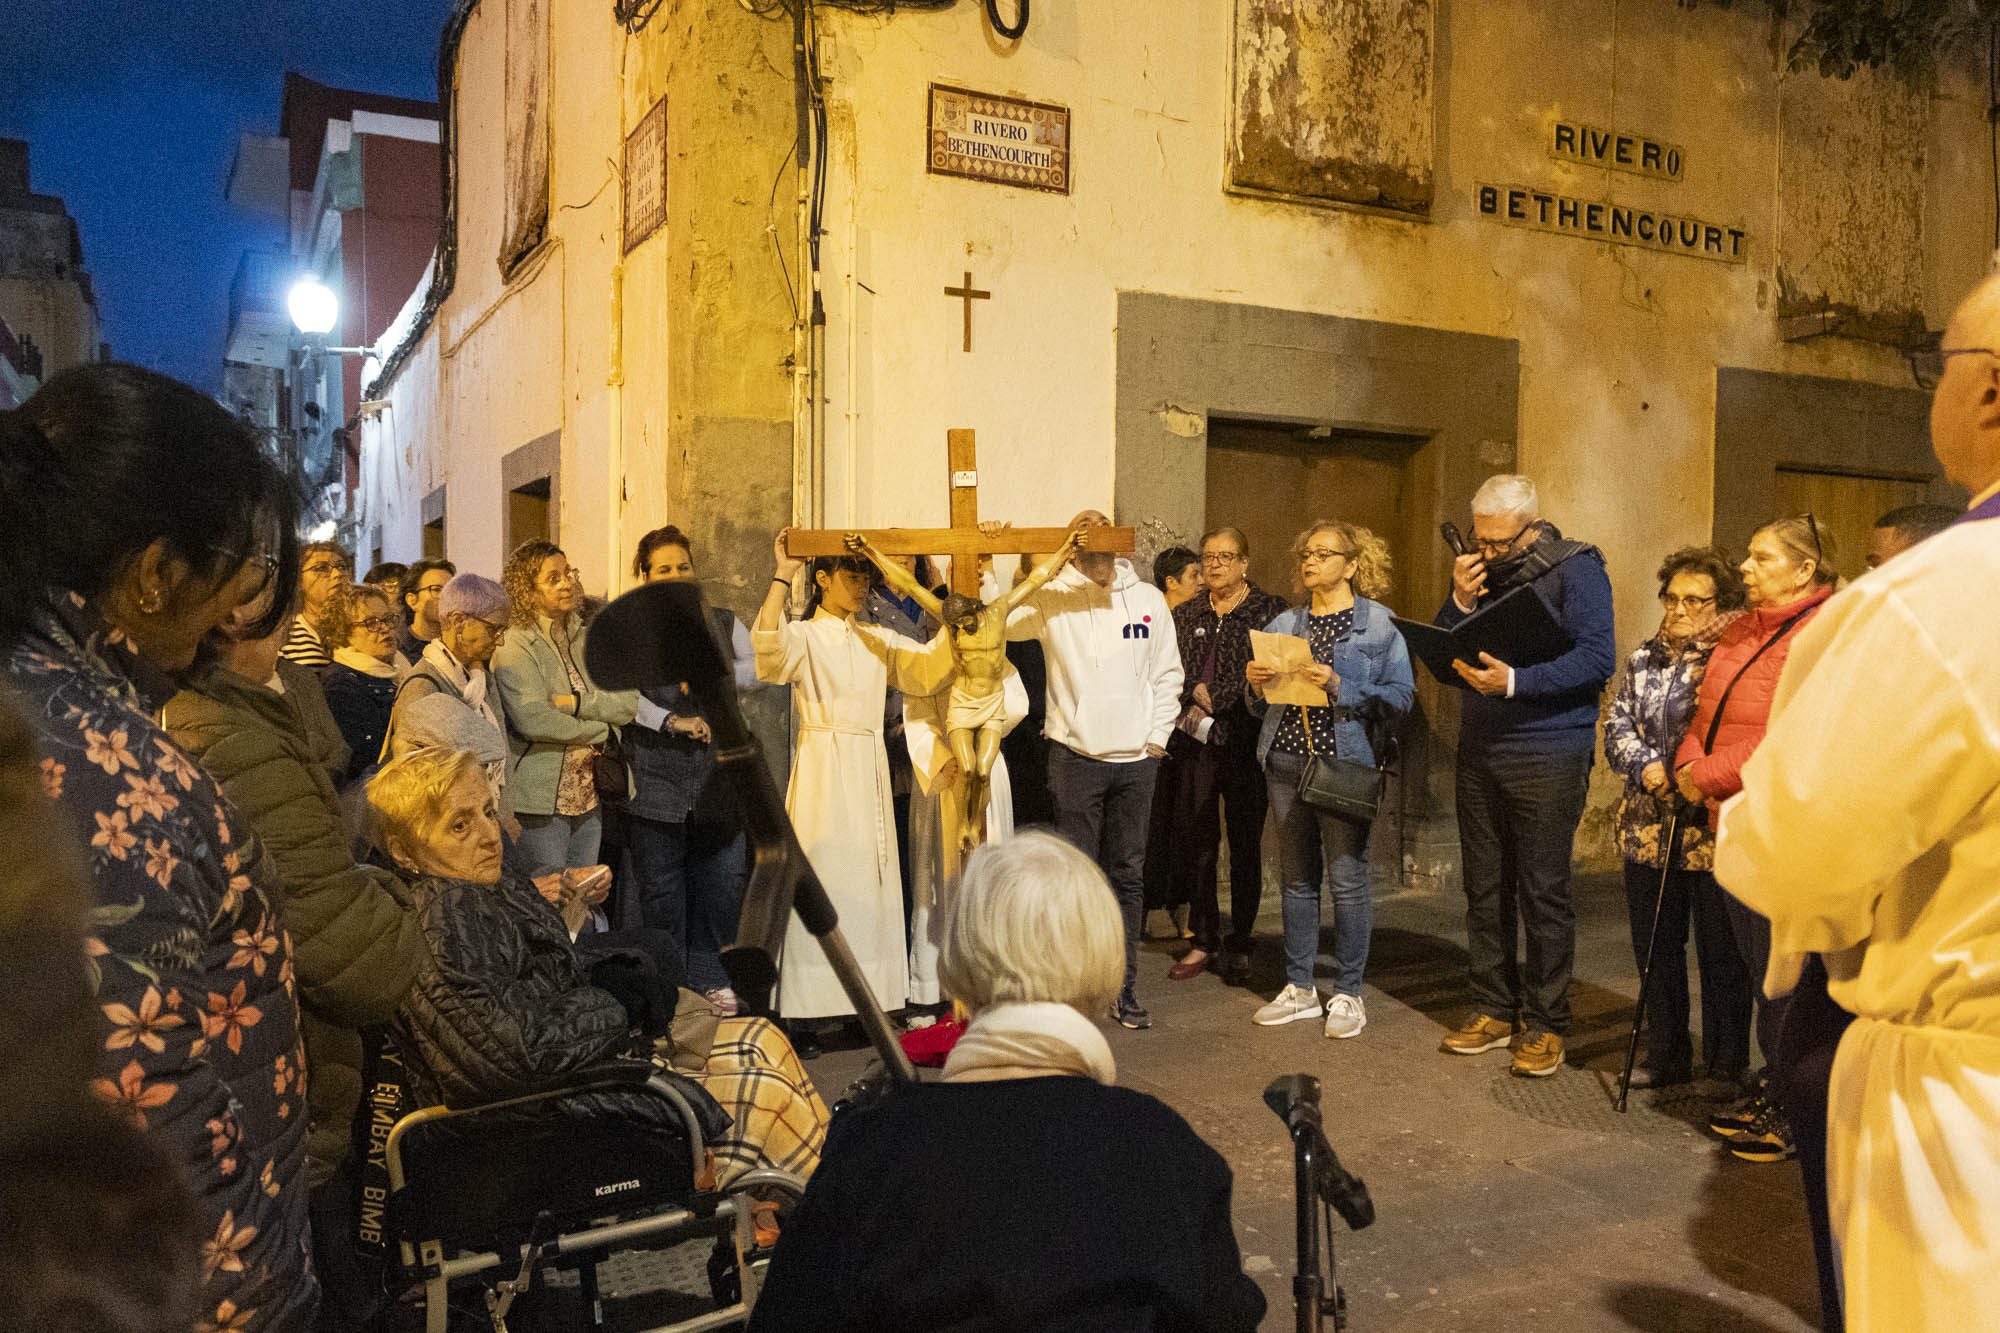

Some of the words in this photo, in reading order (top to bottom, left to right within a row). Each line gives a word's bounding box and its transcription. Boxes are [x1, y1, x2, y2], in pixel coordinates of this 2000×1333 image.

[973, 119, 1028, 142] RIVERO
[1555, 124, 1680, 177] RIVERO
[948, 136, 1050, 169] BETHENCOURTH
[1479, 186, 1745, 256] BETHENCOURT
